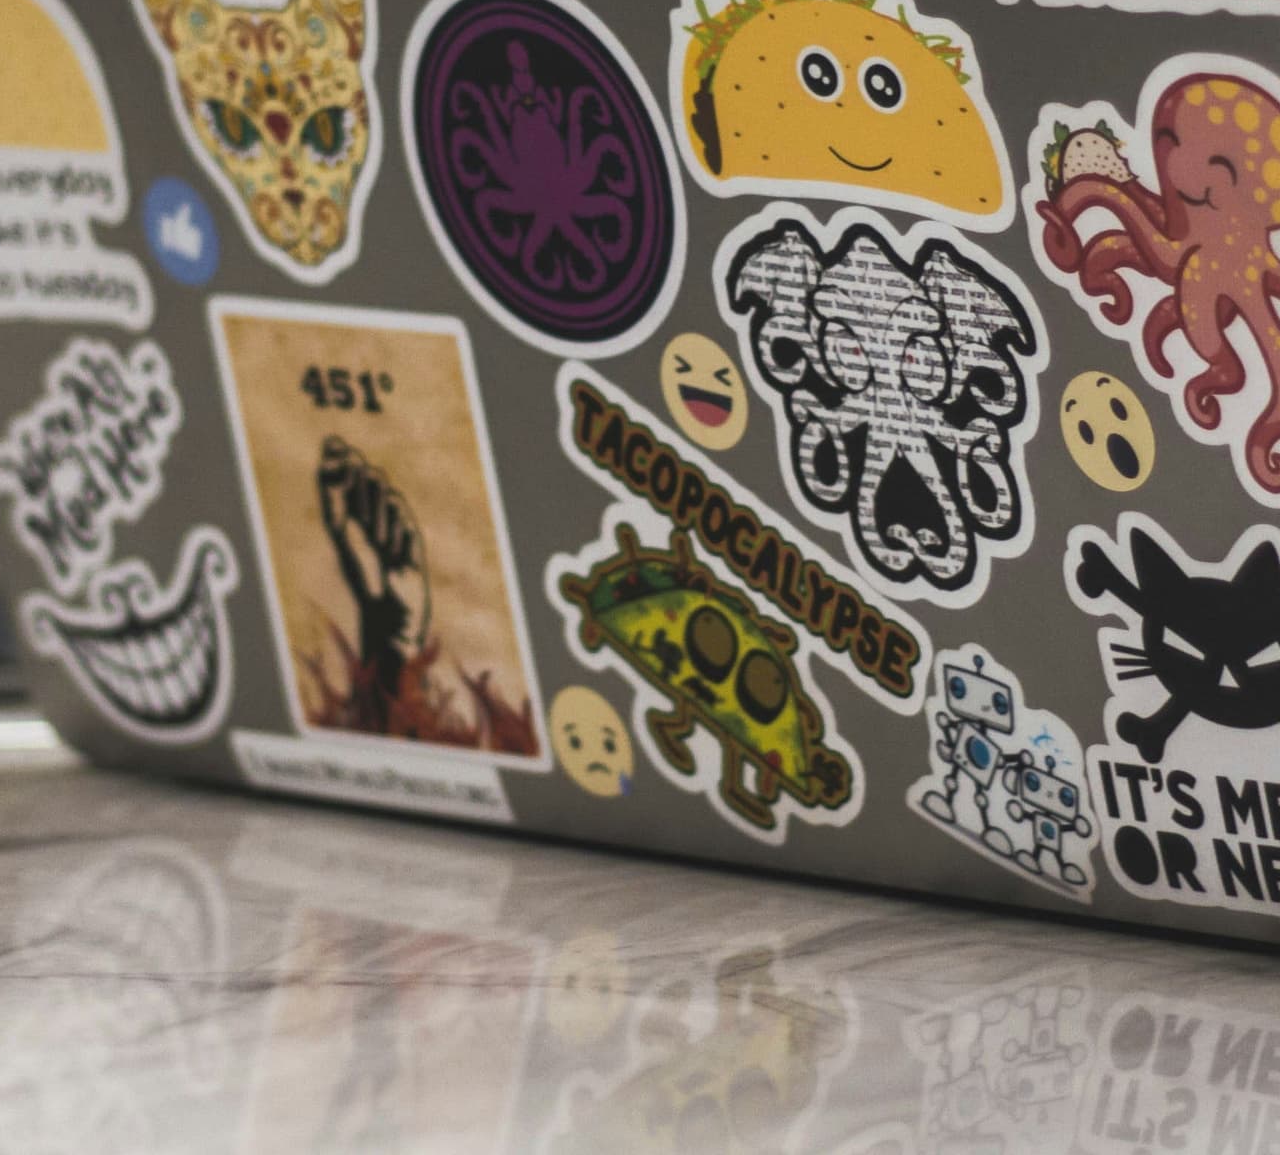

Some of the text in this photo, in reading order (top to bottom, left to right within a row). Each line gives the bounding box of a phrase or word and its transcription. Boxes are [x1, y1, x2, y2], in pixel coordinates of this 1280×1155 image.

[572, 381, 919, 695] TACOPOCALYPSE
[1098, 760, 1204, 829] IT'S
[1113, 825, 1206, 893] OR
